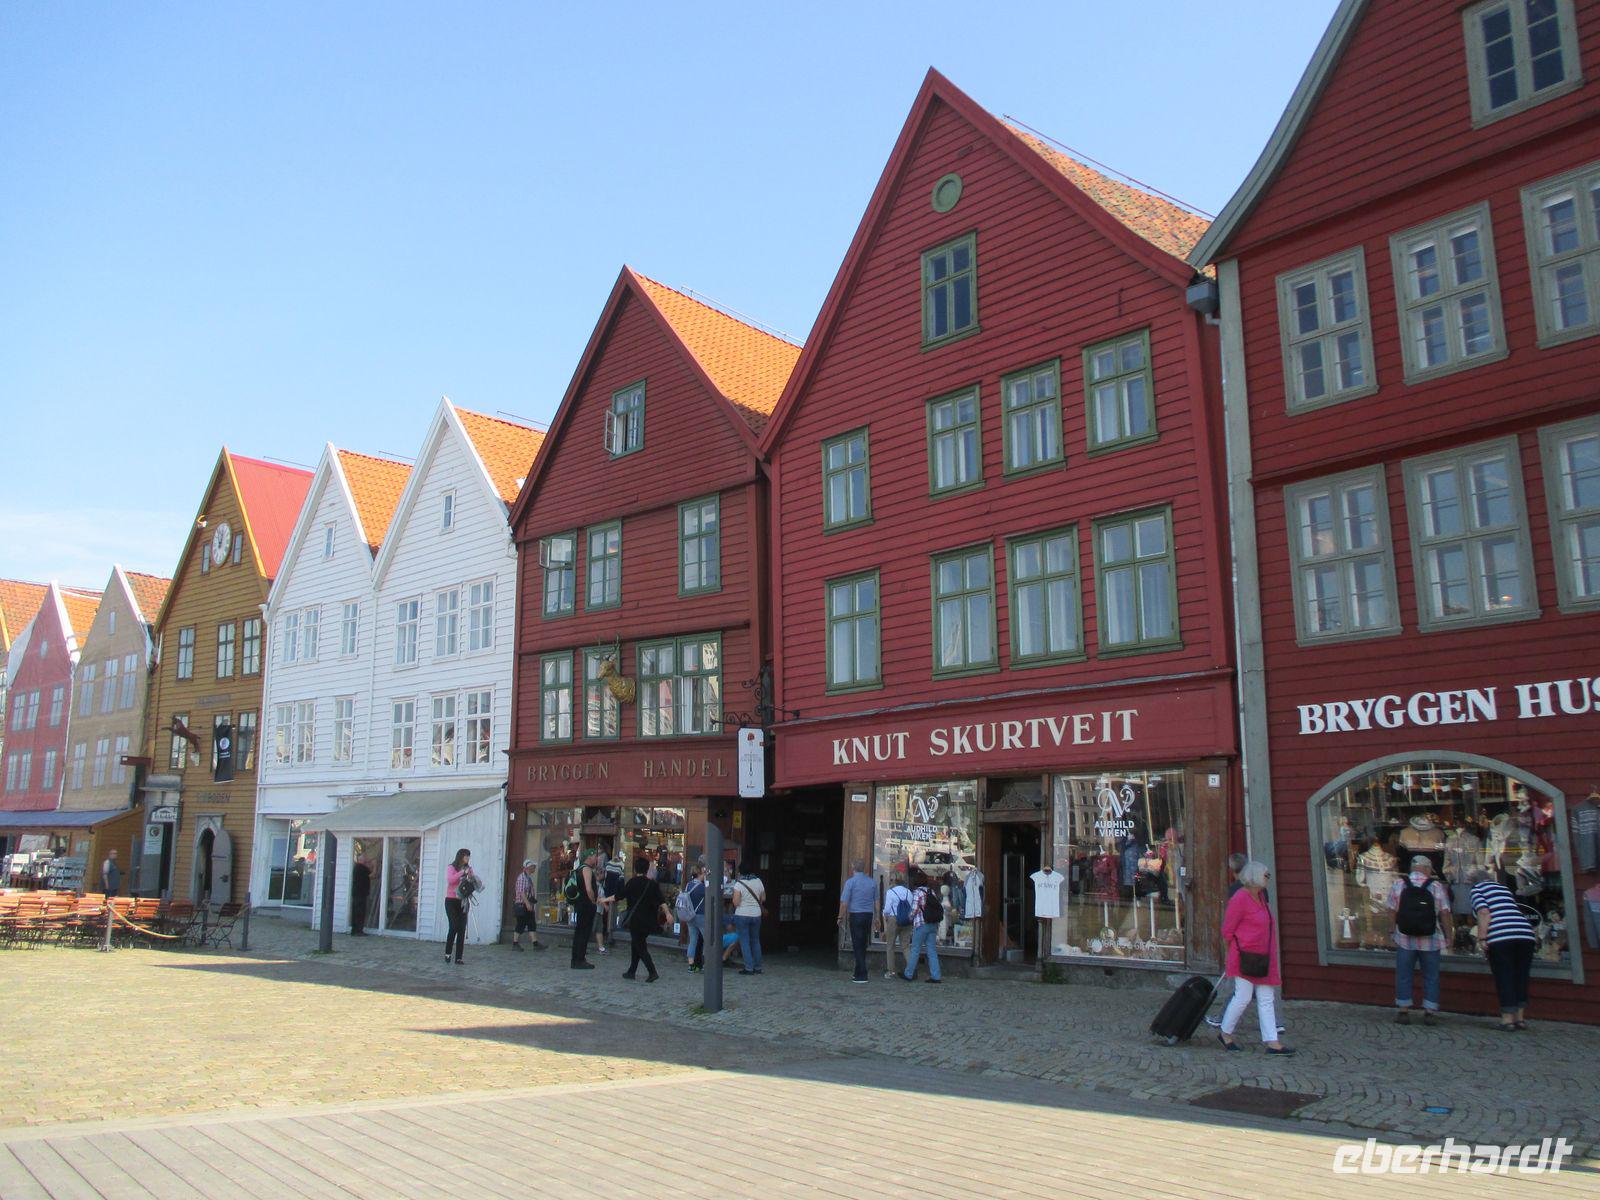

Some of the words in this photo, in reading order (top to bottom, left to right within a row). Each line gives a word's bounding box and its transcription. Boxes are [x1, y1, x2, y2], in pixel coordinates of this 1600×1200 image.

[1297, 687, 1498, 735] BRYGGEN
[832, 732, 910, 765] KNUT
[929, 709, 1138, 756] SKURTVEIT
[527, 763, 609, 782] BRYGGEN
[643, 758, 729, 778] HANDEL
[905, 825, 938, 833] AUDHILD
[1094, 820, 1135, 829] AUDHILD
[1099, 829, 1128, 838] VIKEN
